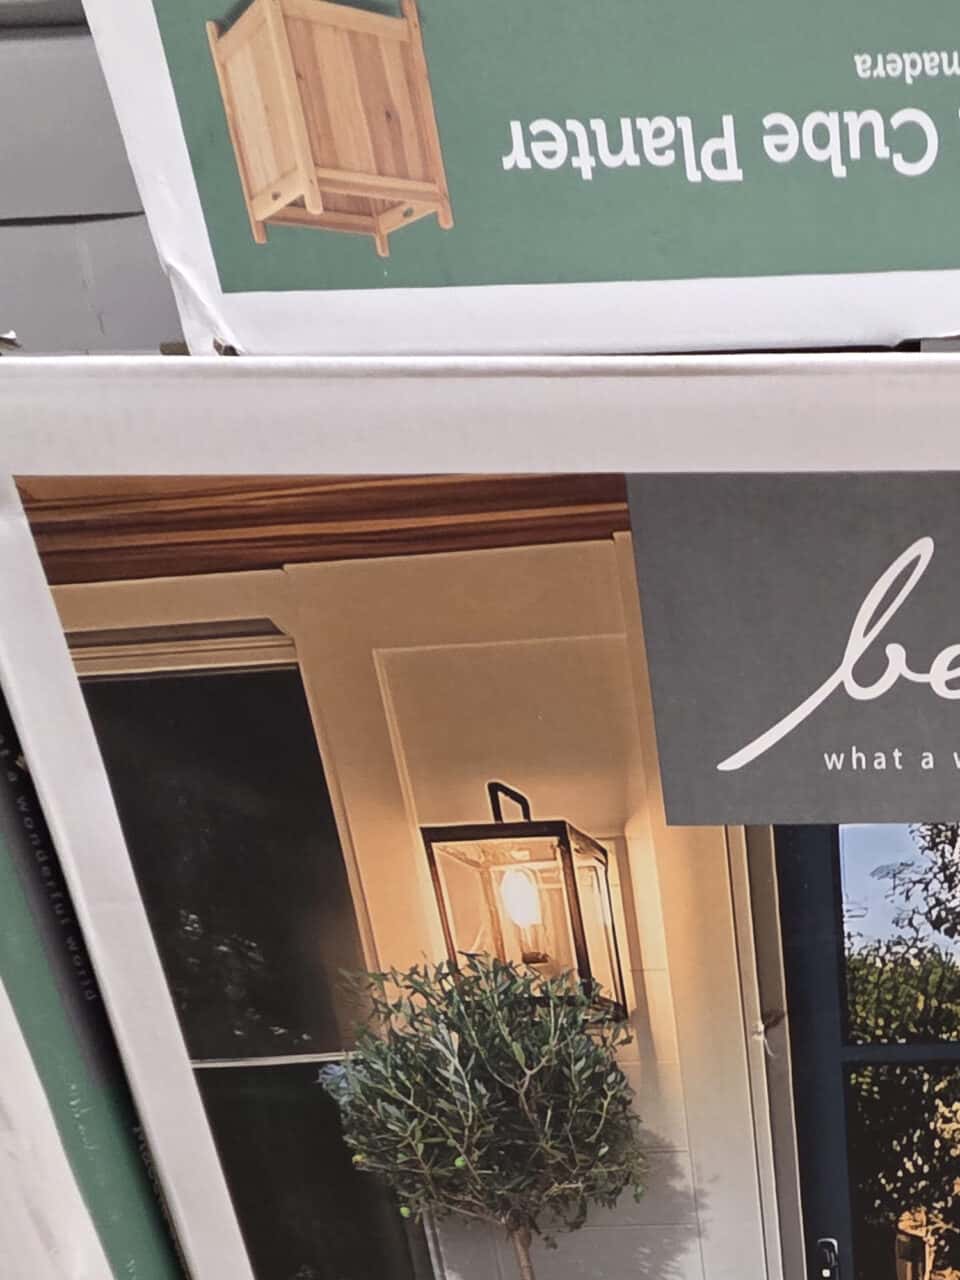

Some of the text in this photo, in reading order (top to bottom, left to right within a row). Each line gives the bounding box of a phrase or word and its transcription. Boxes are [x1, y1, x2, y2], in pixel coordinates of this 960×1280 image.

[501, 113, 743, 183] Planter
[761, 107, 939, 177] Cube
[823, 744, 903, 771] what
[920, 749, 935, 770] a
